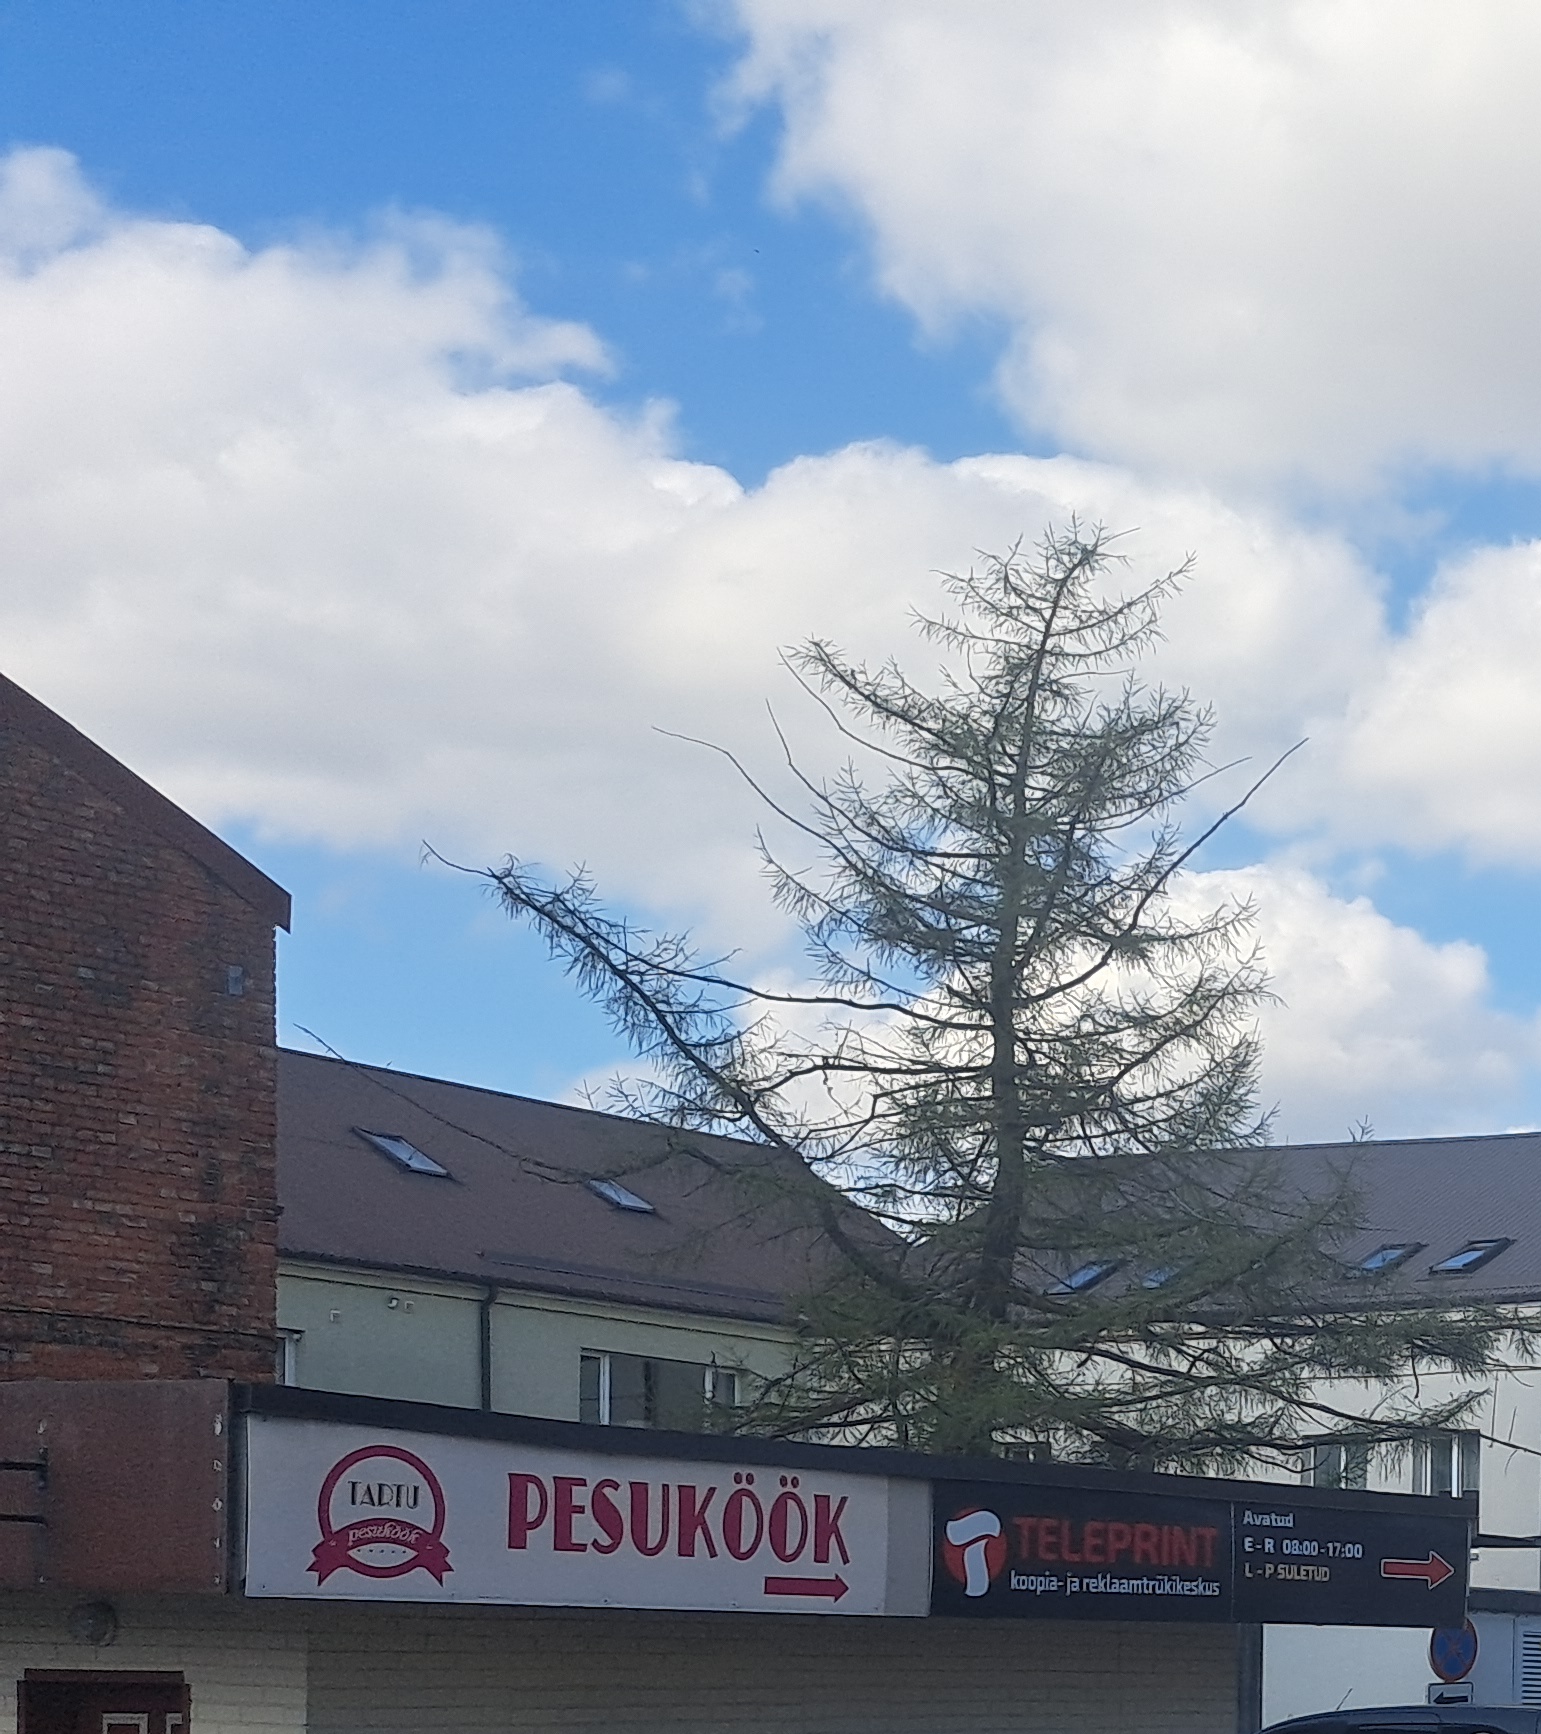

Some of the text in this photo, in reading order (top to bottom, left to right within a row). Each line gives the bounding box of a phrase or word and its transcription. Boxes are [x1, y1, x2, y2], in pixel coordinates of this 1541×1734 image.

[348, 1480, 420, 1509] TARTU
[507, 1472, 850, 1565] PESUKÖÖK
[1243, 1510, 1294, 1528] Avatud
[1013, 1516, 1218, 1567] TELEPRINT
[1010, 1570, 1220, 1596] koopia- ja reklaamtrükikeskus
[1277, 1564, 1330, 1581] SULETUD
